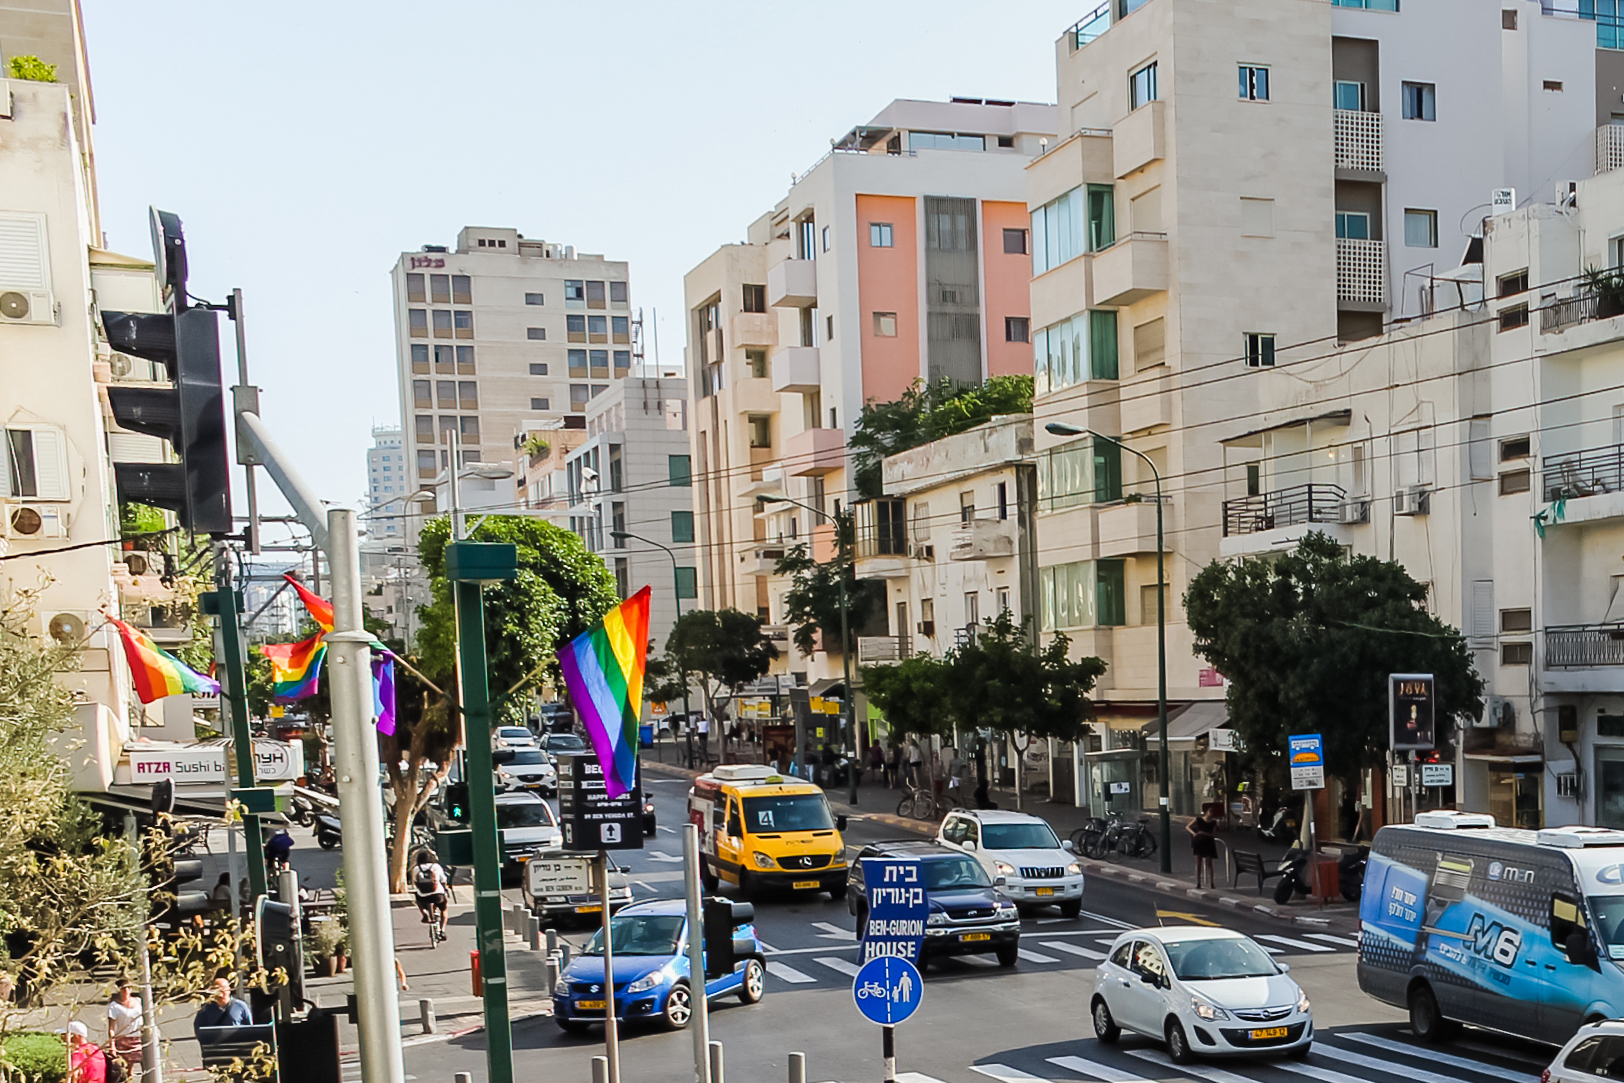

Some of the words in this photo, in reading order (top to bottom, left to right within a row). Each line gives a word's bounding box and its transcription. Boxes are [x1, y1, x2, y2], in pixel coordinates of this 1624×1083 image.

[137, 762, 170, 773] ATZA
[175, 761, 210, 773] Sushi
[884, 866, 917, 882] בית
[873, 888, 923, 908] בן-גוריון
[869, 920, 923, 936] BEN-GURION
[1463, 912, 1522, 969] M6
[865, 941, 916, 958] HOUSE
